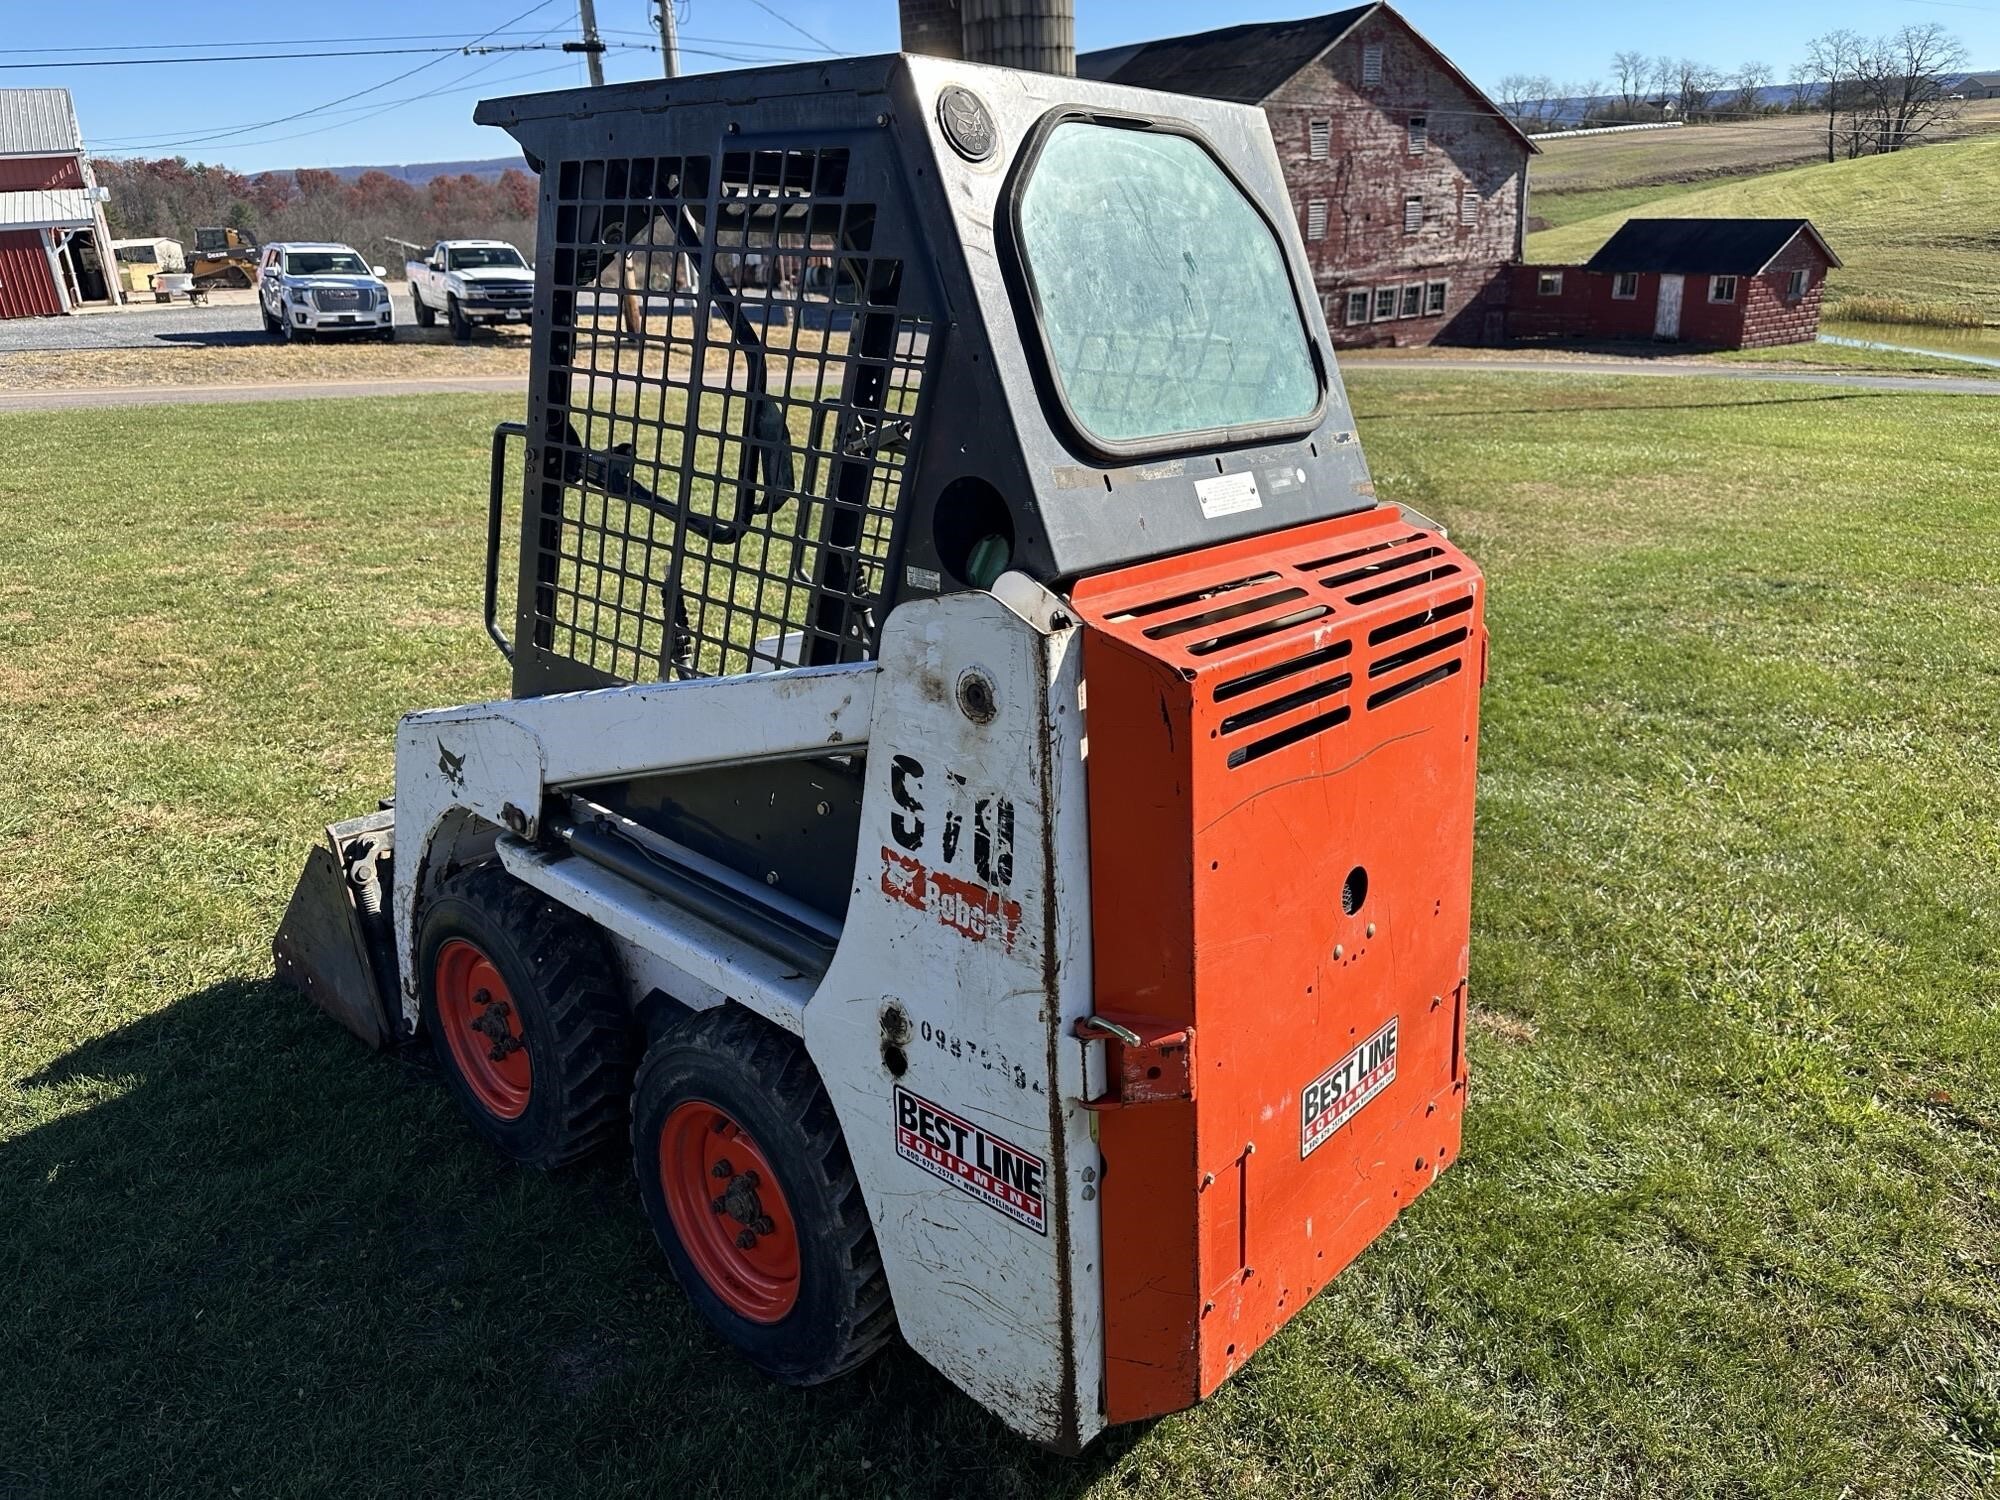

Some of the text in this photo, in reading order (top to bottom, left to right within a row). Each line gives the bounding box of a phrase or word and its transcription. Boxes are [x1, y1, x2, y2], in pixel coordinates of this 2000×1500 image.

[1305, 1026, 1396, 1126] BEST LINE
[1306, 1058, 1395, 1139] EQUIPMENT
[899, 1090, 1042, 1202] BEST LINE
[900, 1145, 955, 1182] 1-800-679-2578
[902, 1132, 1039, 1214] EQUIPMENT
